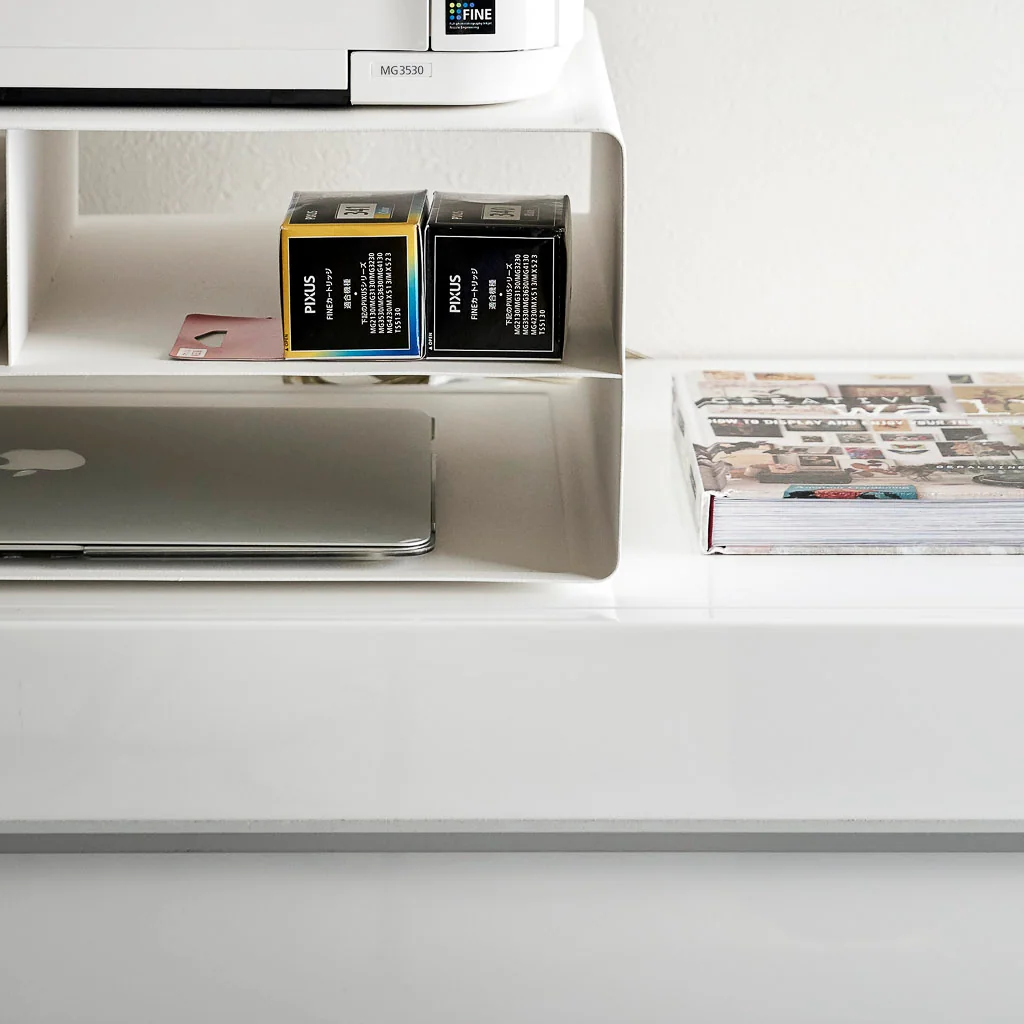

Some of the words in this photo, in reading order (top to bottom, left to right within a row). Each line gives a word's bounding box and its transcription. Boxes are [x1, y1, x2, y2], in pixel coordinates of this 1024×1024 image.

[463, 8, 492, 20] FINE
[380, 66, 424, 75] MG3530
[304, 275, 316, 314] PIXUS
[325, 268, 334, 320] FINEカートリッジ
[360, 262, 368, 324] 下記のPIXUSシリーズ
[368, 252, 376, 334] MG2130/MG3130/MG3230
[449, 274, 461, 312] PIXUS
[470, 268, 479, 320] FINEカートリッジ
[505, 263, 513, 326] 下記のPIXUSシリーズ
[514, 254, 522, 335] MG2130/MG3130/MG3230
[394, 308, 402, 334] TS5130
[538, 310, 546, 334] TS5130
